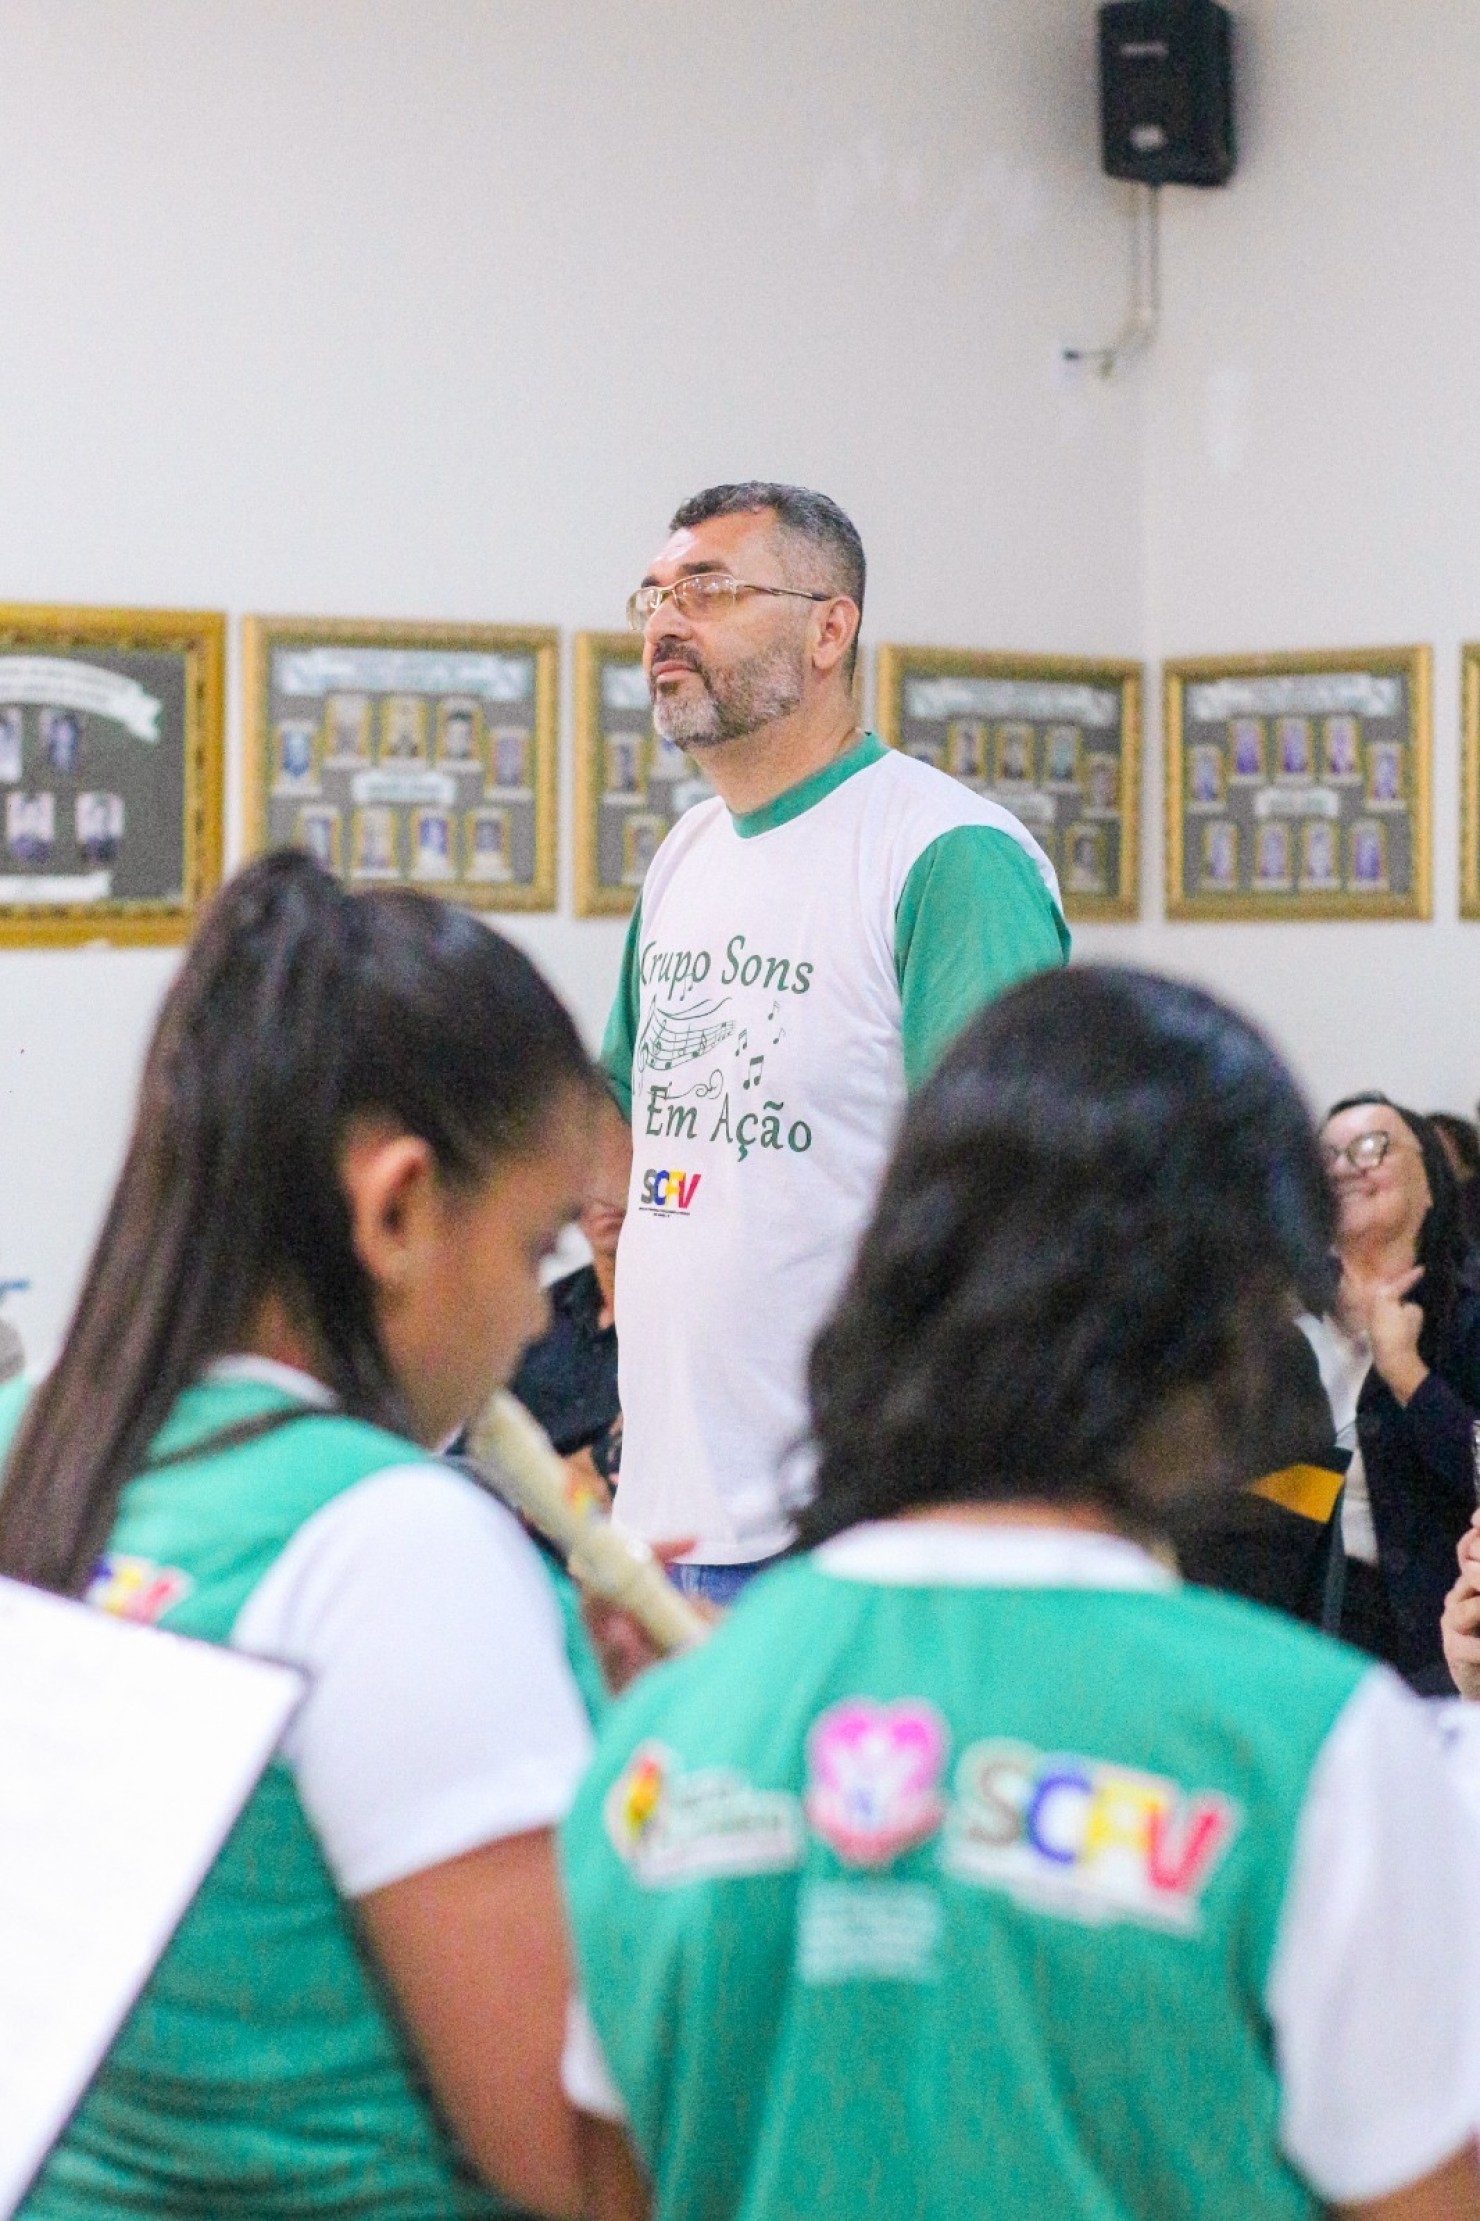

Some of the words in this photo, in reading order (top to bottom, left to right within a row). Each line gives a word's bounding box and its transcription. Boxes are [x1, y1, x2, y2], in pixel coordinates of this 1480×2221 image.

[721, 935, 814, 994] Sons
[646, 1084, 698, 1139] Em
[709, 1092, 812, 1162] Ação
[640, 1168, 702, 1209] SCFV
